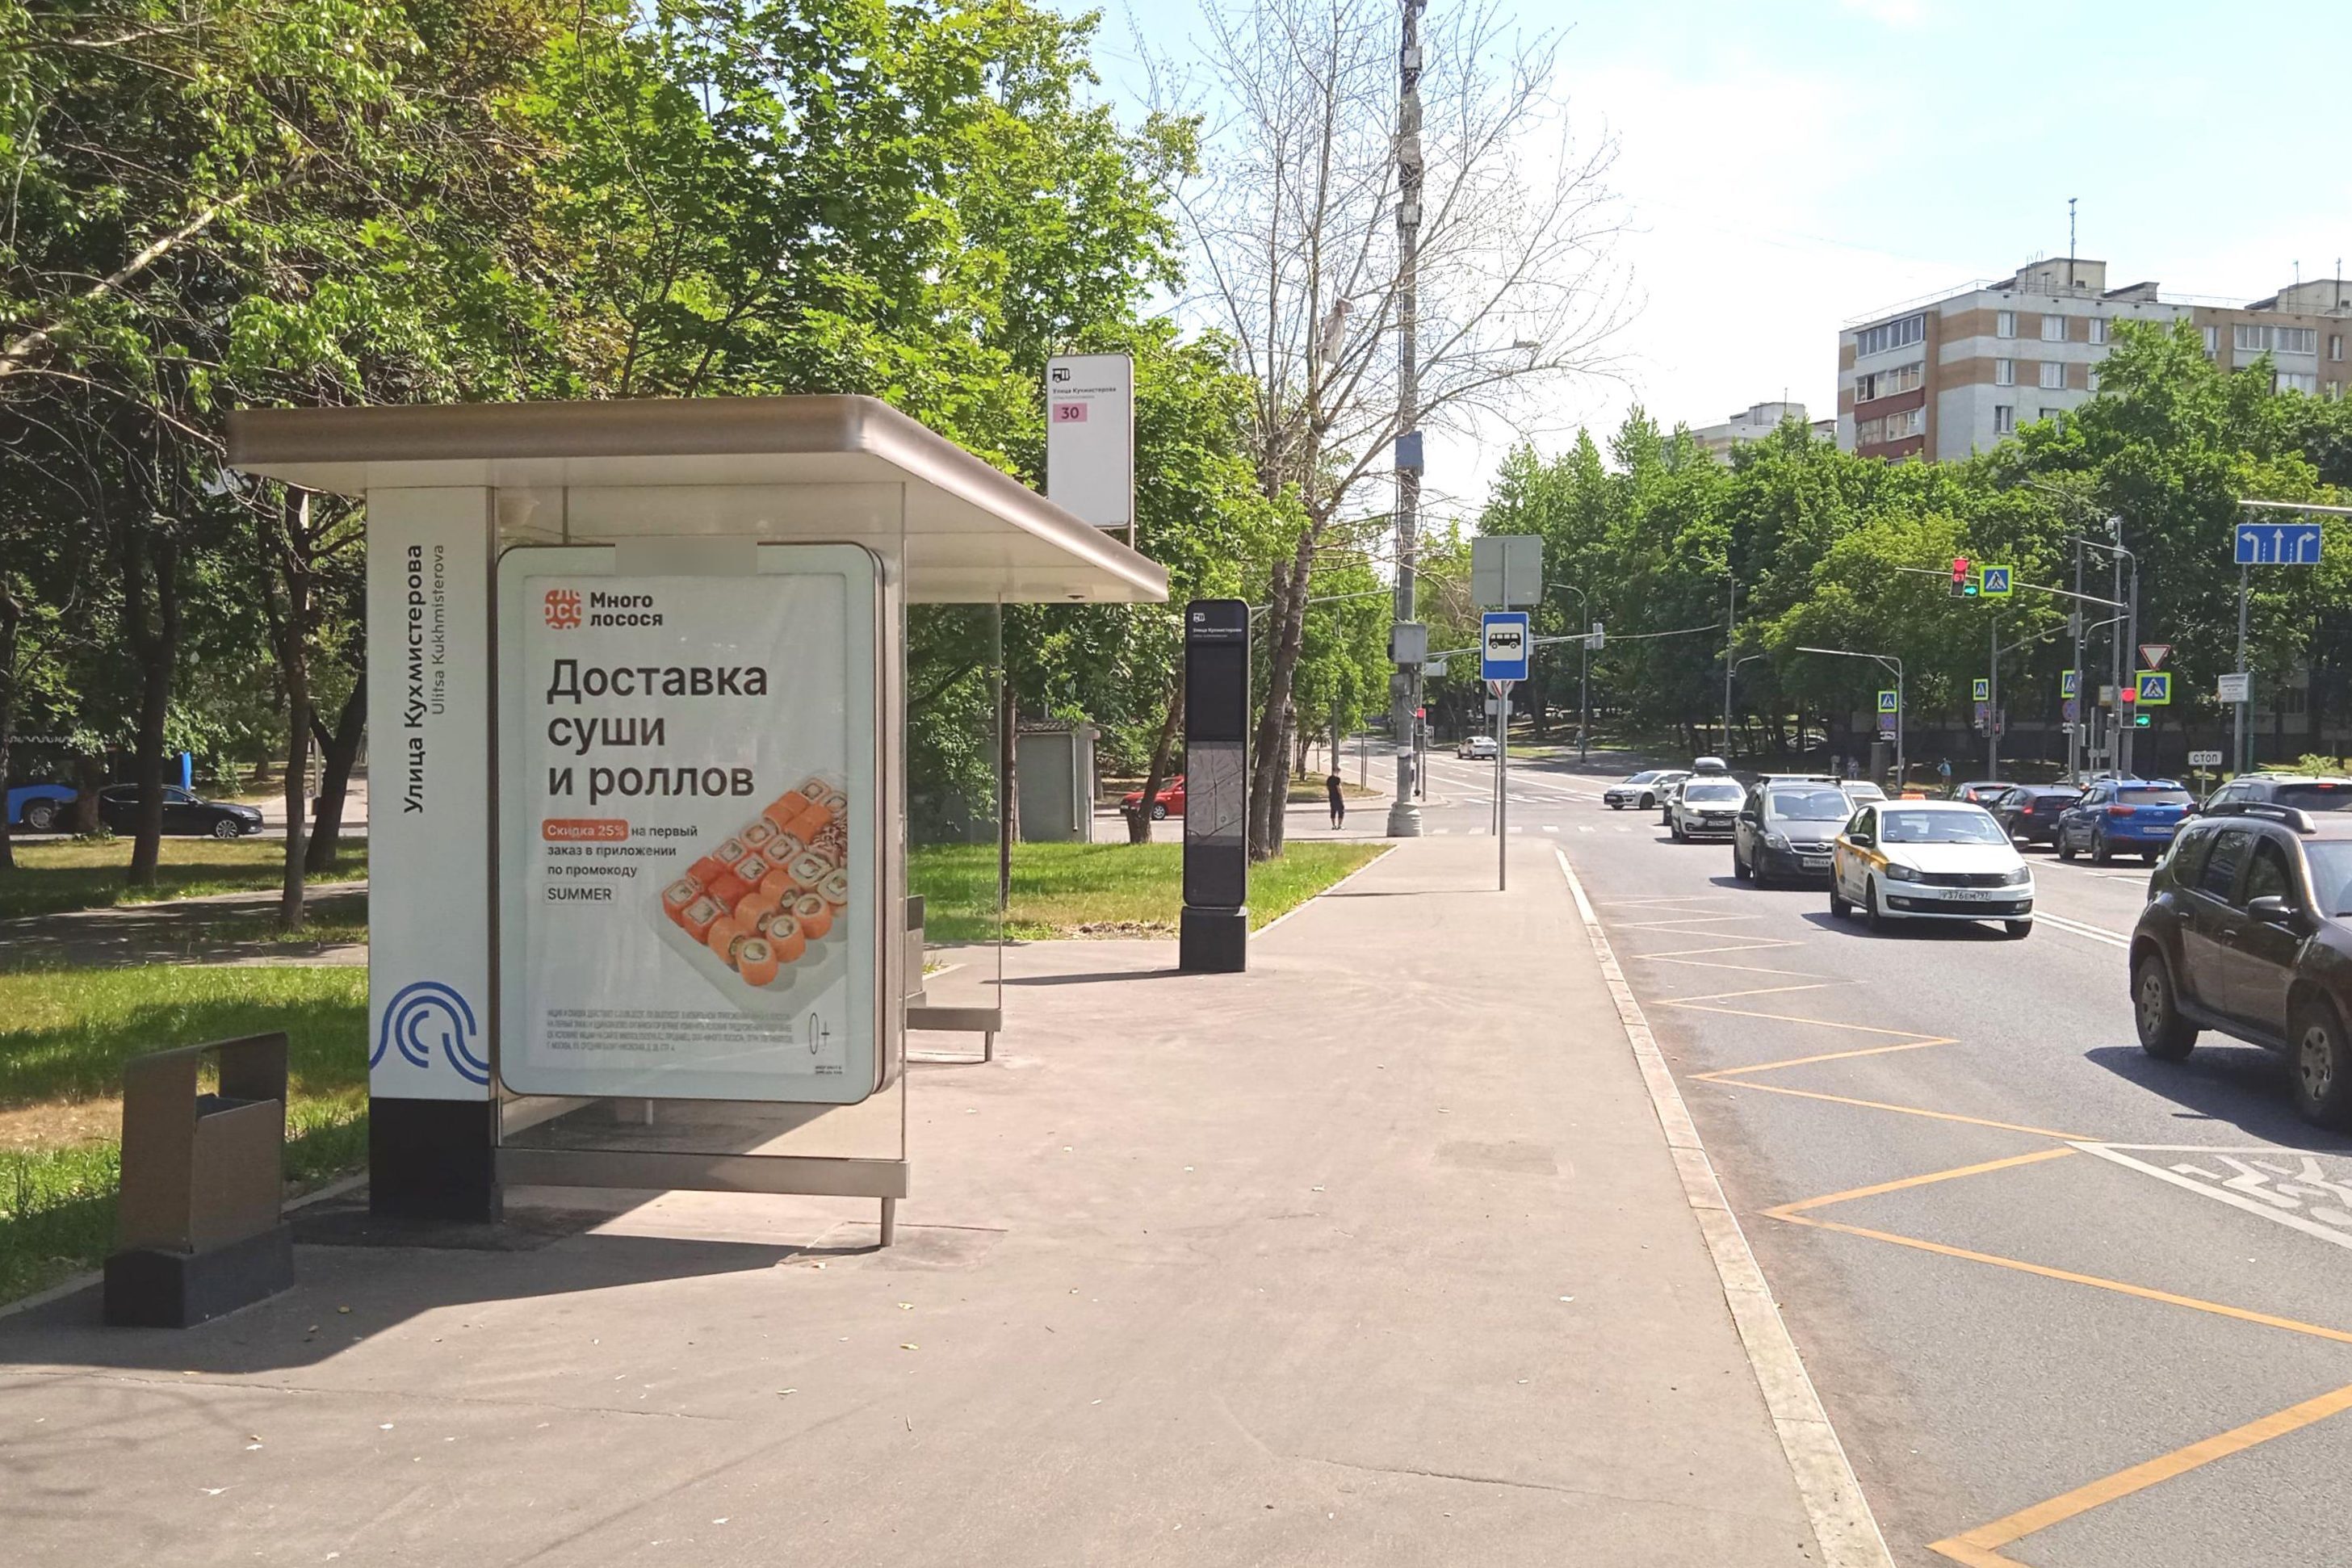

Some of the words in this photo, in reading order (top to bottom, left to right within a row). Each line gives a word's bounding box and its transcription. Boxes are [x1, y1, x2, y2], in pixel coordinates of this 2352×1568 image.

[1061, 407, 1079, 419] 30
[431, 545, 444, 665] Kukhmisterova
[590, 592, 653, 607] Много
[404, 545, 427, 728] Кухмистерова
[590, 614, 663, 627] лосося
[432, 669, 444, 715] Ulitsa
[547, 659, 767, 705] Доставка
[548, 717, 665, 756] суши
[404, 737, 426, 813] Улица
[549, 767, 572, 795] и
[589, 767, 754, 805] роллов
[547, 824, 594, 838] Скидка
[597, 824, 624, 836] 25%
[631, 827, 646, 836] на
[649, 826, 698, 839] первый
[547, 847, 582, 856] заказ
[585, 847, 593, 856] в
[596, 847, 677, 858] приложении
[547, 866, 563, 874] по
[566, 866, 637, 878] промокоду
[547, 887, 612, 900] SUMMER
[808, 1012, 831, 1055] 0+
